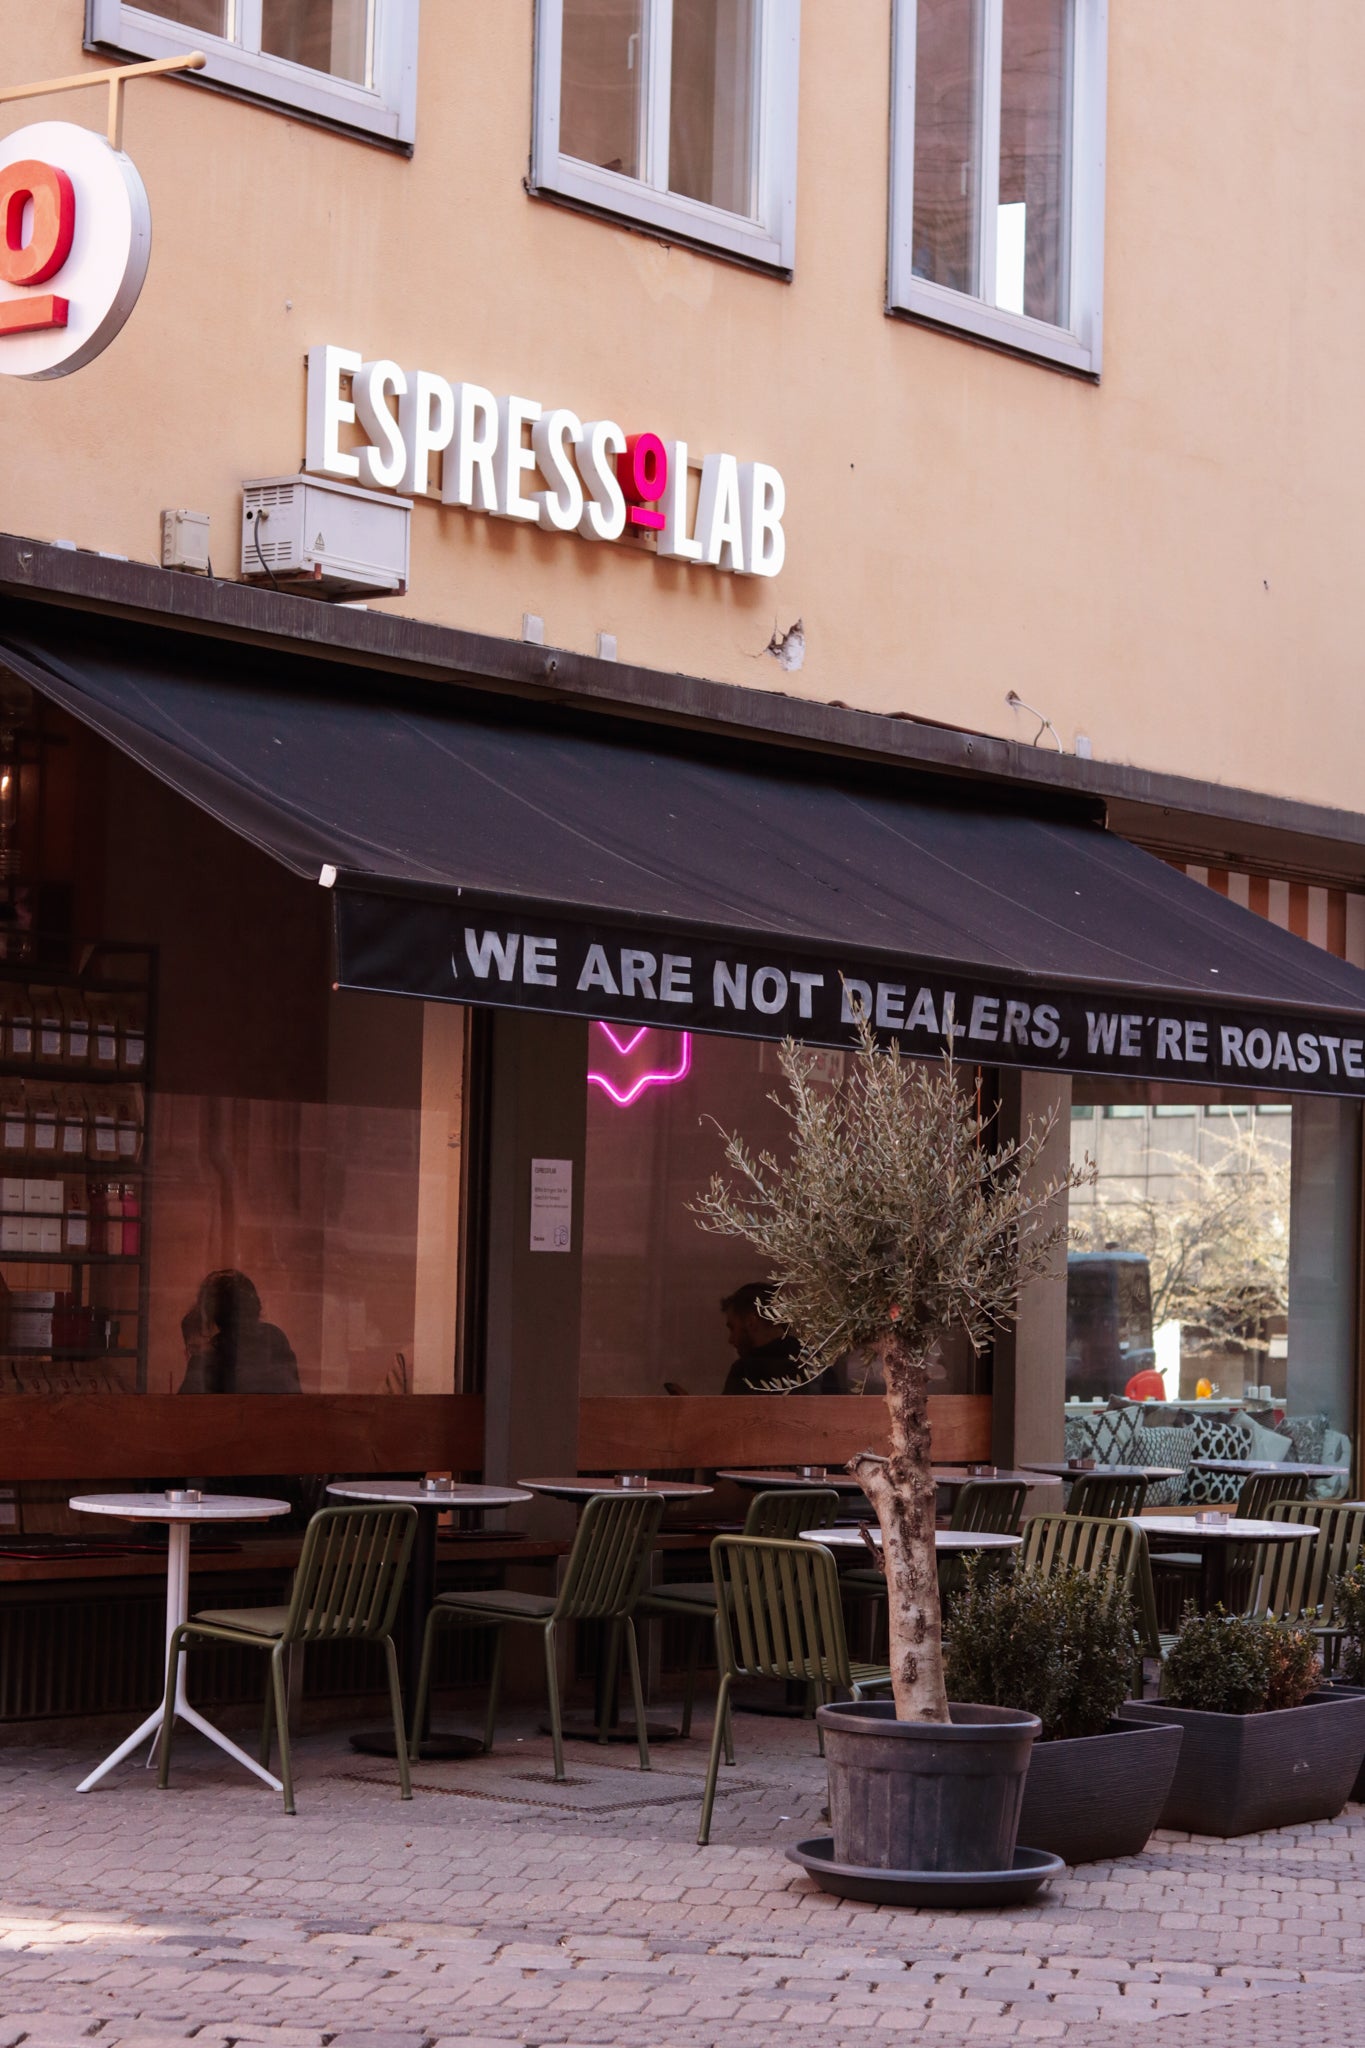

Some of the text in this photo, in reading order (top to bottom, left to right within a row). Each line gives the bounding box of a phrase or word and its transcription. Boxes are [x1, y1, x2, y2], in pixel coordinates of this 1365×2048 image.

[464, 928, 558, 987] WE
[576, 943, 693, 1004] ARE
[712, 960, 824, 1019] NOT
[840, 977, 1070, 1060] DEALERS,
[1220, 1025, 1365, 1078] ROASTE
